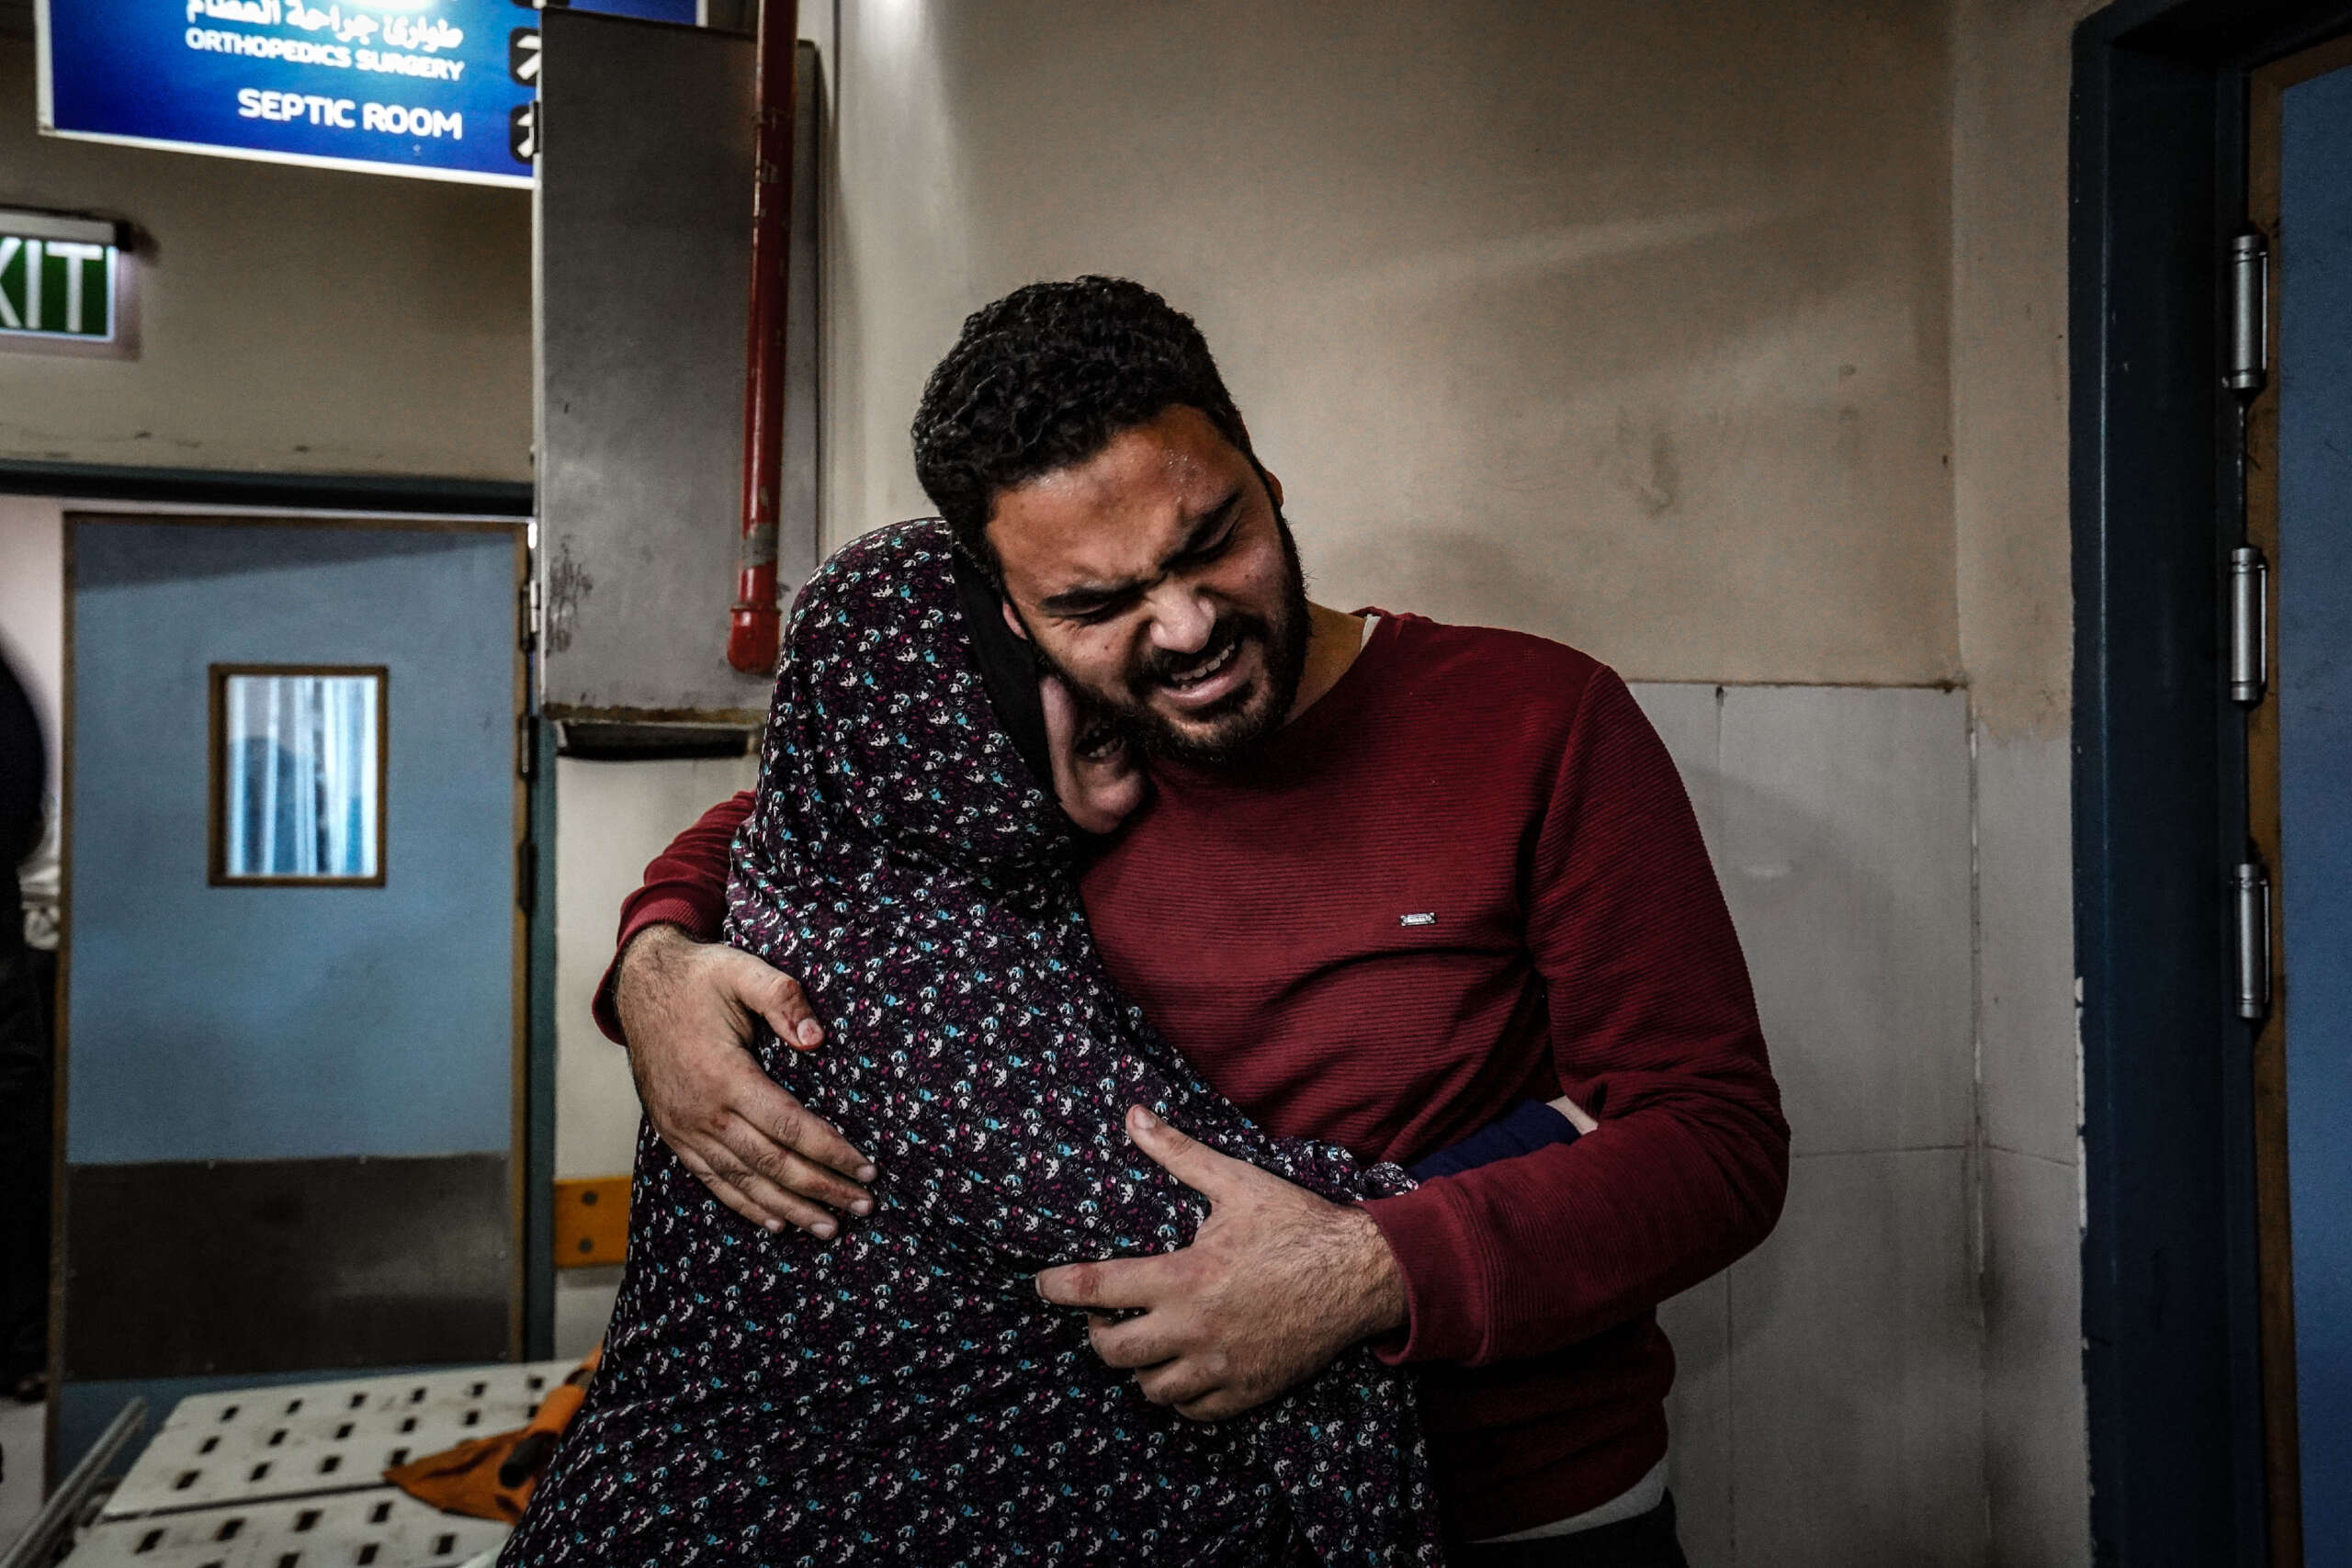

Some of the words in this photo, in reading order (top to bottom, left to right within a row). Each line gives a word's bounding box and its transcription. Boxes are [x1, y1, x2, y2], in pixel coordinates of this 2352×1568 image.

[185, 27, 353, 67] ORTHOPEDICS
[356, 49, 466, 81] SURGERY
[237, 87, 356, 129] SEPTIC
[362, 102, 463, 140] ROOM
